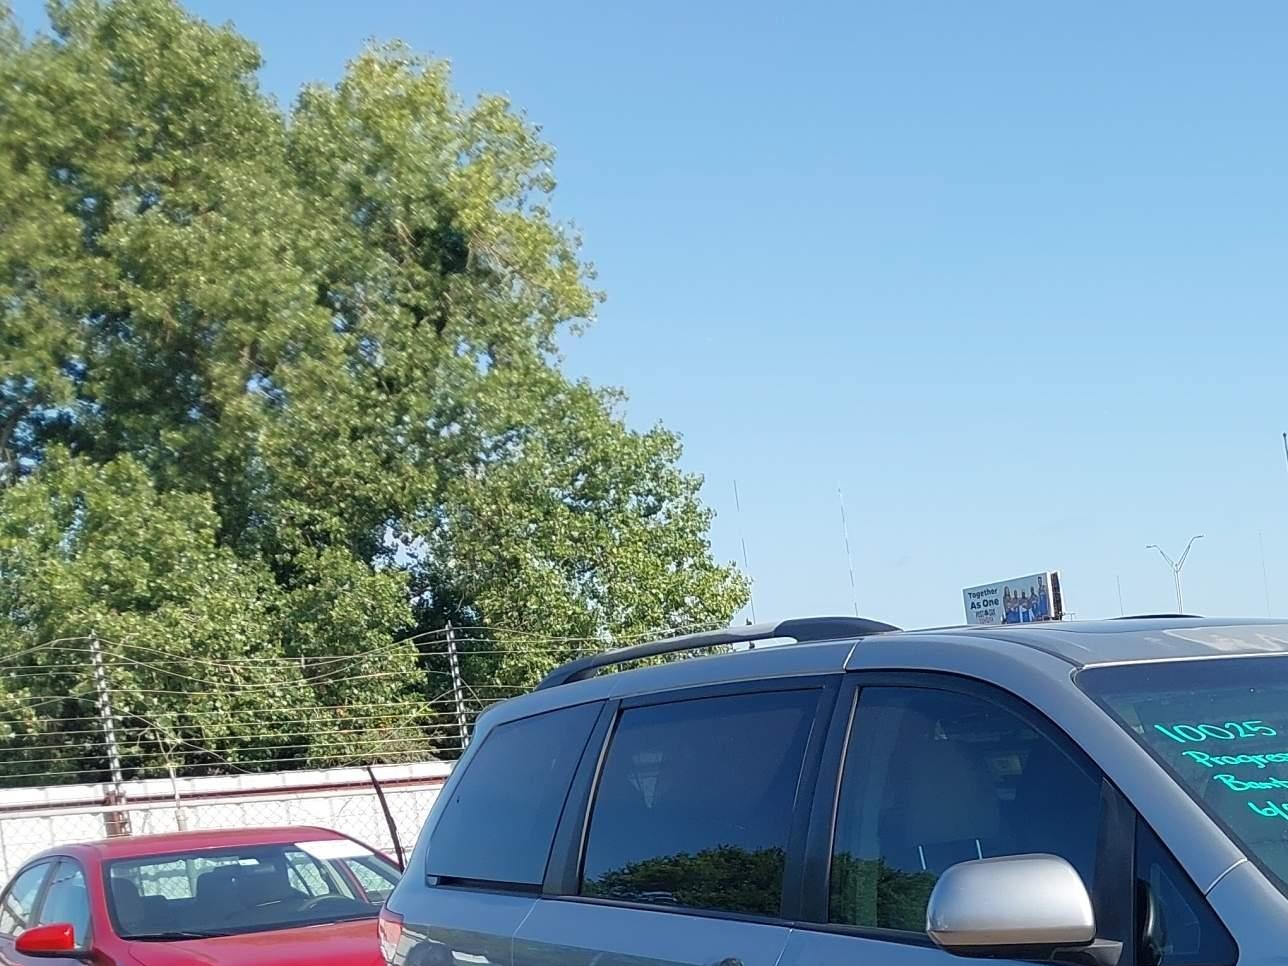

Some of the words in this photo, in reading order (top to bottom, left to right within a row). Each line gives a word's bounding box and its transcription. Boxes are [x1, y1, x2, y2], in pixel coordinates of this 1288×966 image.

[968, 588, 998, 599] Together
[970, 601, 982, 610] As
[982, 598, 1000, 608] One
[1154, 720, 1277, 743] 10025
